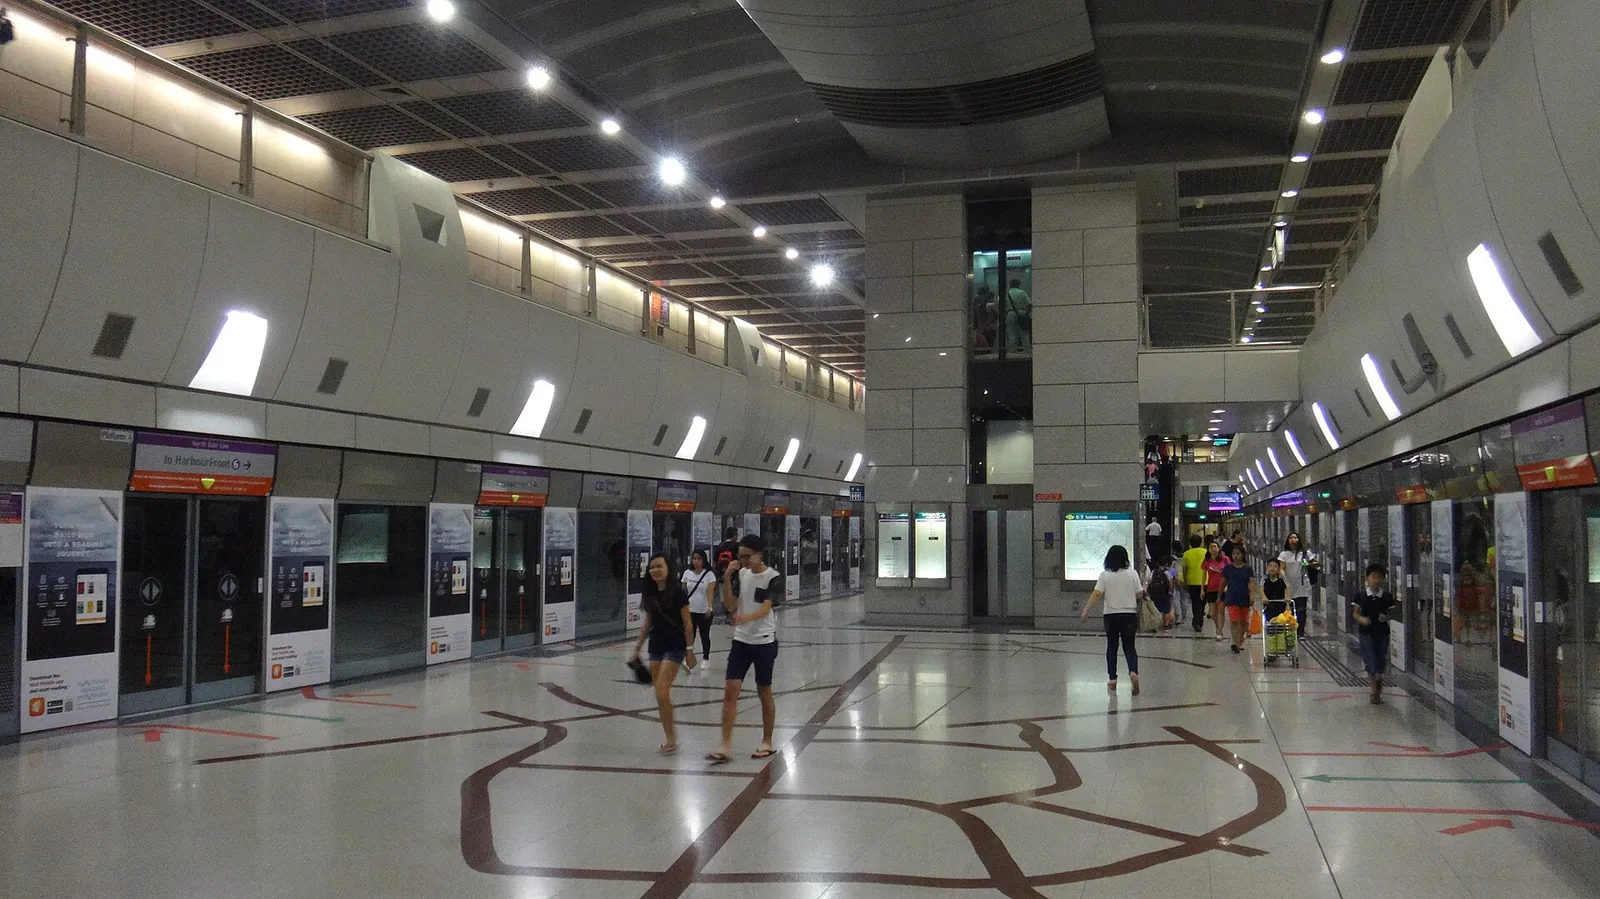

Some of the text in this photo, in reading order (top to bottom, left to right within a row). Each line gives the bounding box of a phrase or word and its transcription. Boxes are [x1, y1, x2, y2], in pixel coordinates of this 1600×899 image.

[101, 430, 127, 440] Platform
[164, 455, 173, 464] to
[174, 455, 230, 469] HarbourFront
